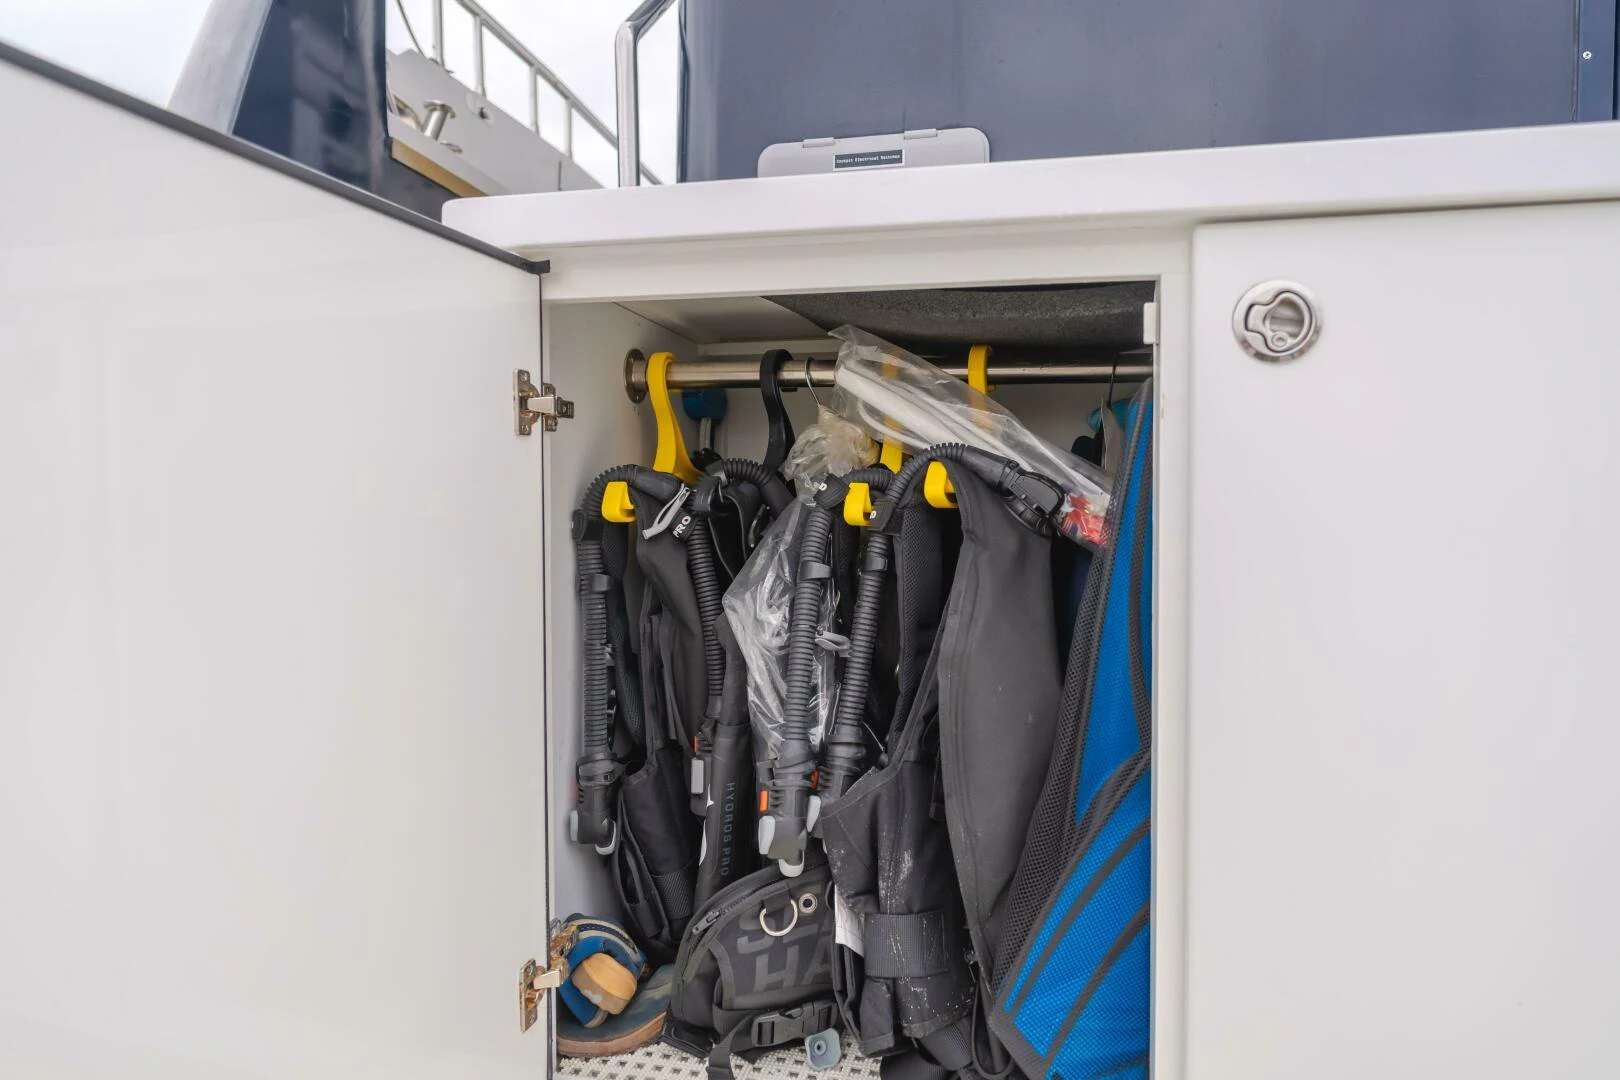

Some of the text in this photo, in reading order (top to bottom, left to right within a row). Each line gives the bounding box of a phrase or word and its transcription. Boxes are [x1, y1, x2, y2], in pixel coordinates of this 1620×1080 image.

[672, 515, 691, 538] PRO
[720, 782, 736, 876] HYDROS PRO
